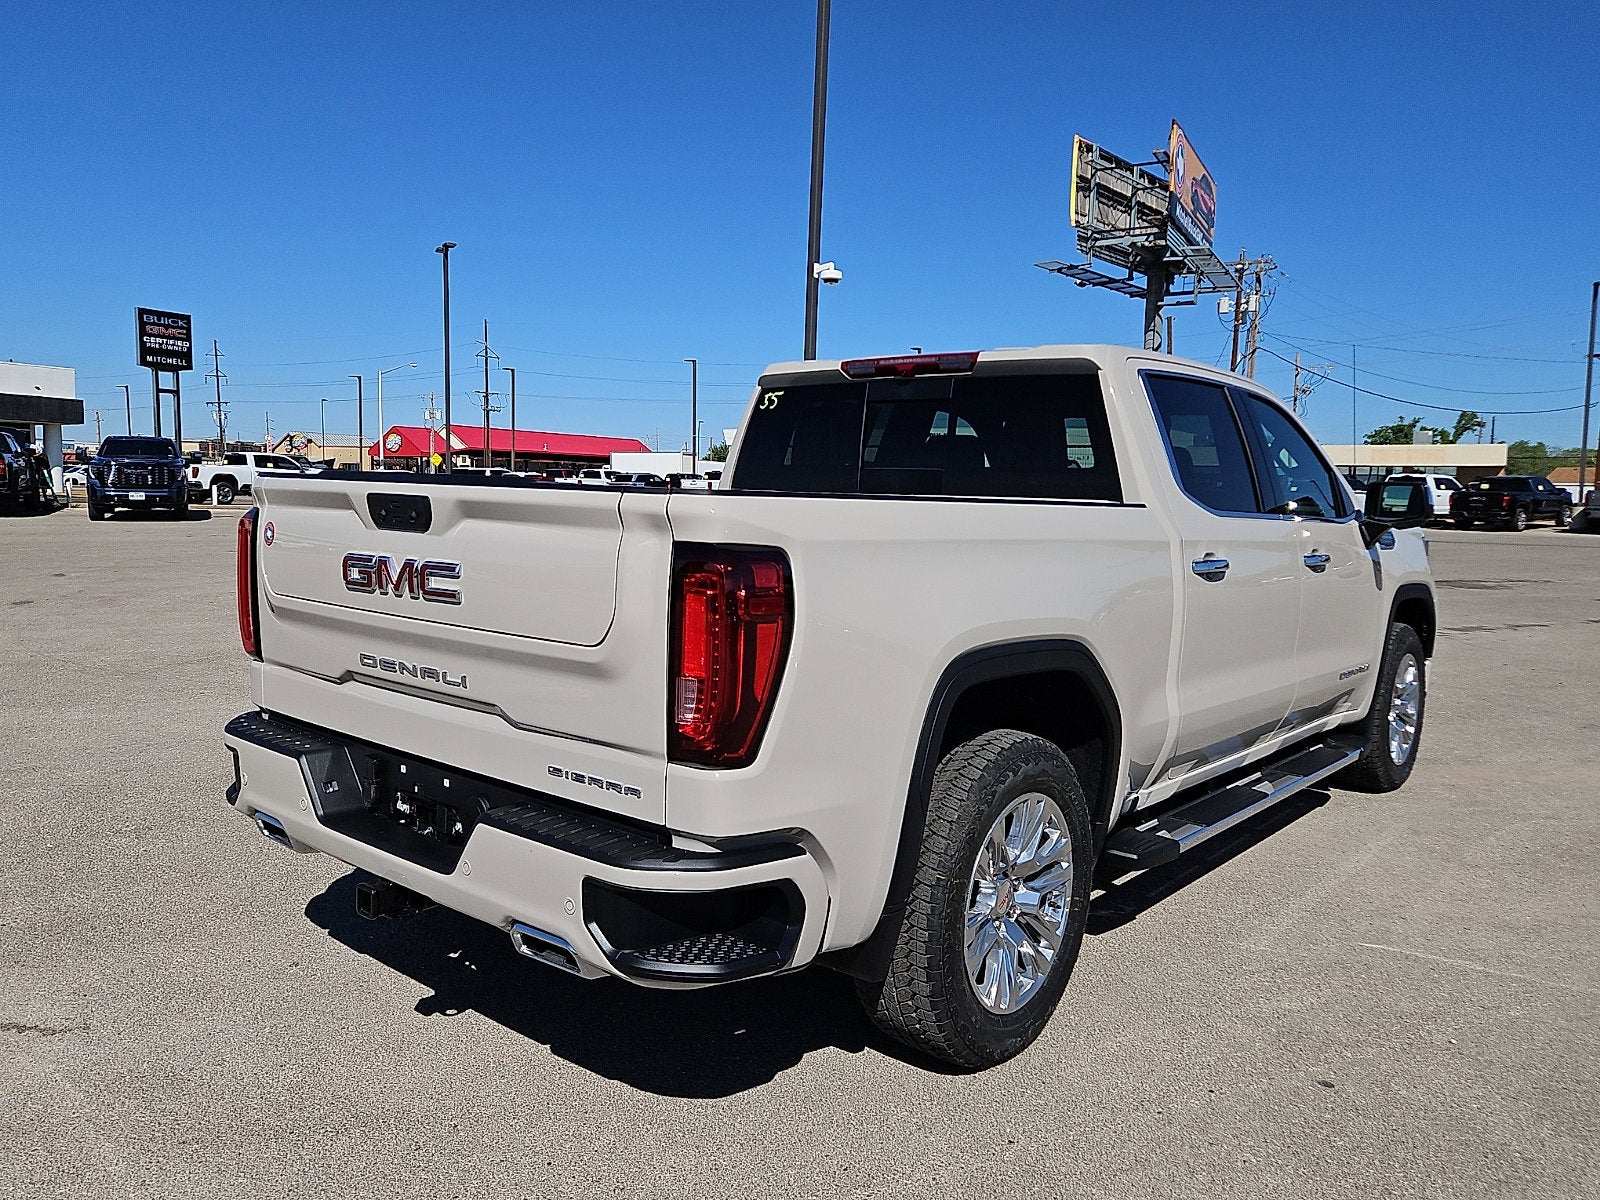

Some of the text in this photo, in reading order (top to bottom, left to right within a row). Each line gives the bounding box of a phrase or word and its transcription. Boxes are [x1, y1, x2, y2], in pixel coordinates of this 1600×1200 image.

[143, 315, 188, 327] BUICK
[146, 325, 186, 338] GMC
[143, 336, 189, 347] CERTIFIED
[146, 342, 188, 352] PRE-OWNED
[146, 355, 188, 366] MITCHELL
[342, 551, 463, 606] GMC
[359, 652, 468, 690] DENALI
[546, 764, 643, 800] SIERRA
